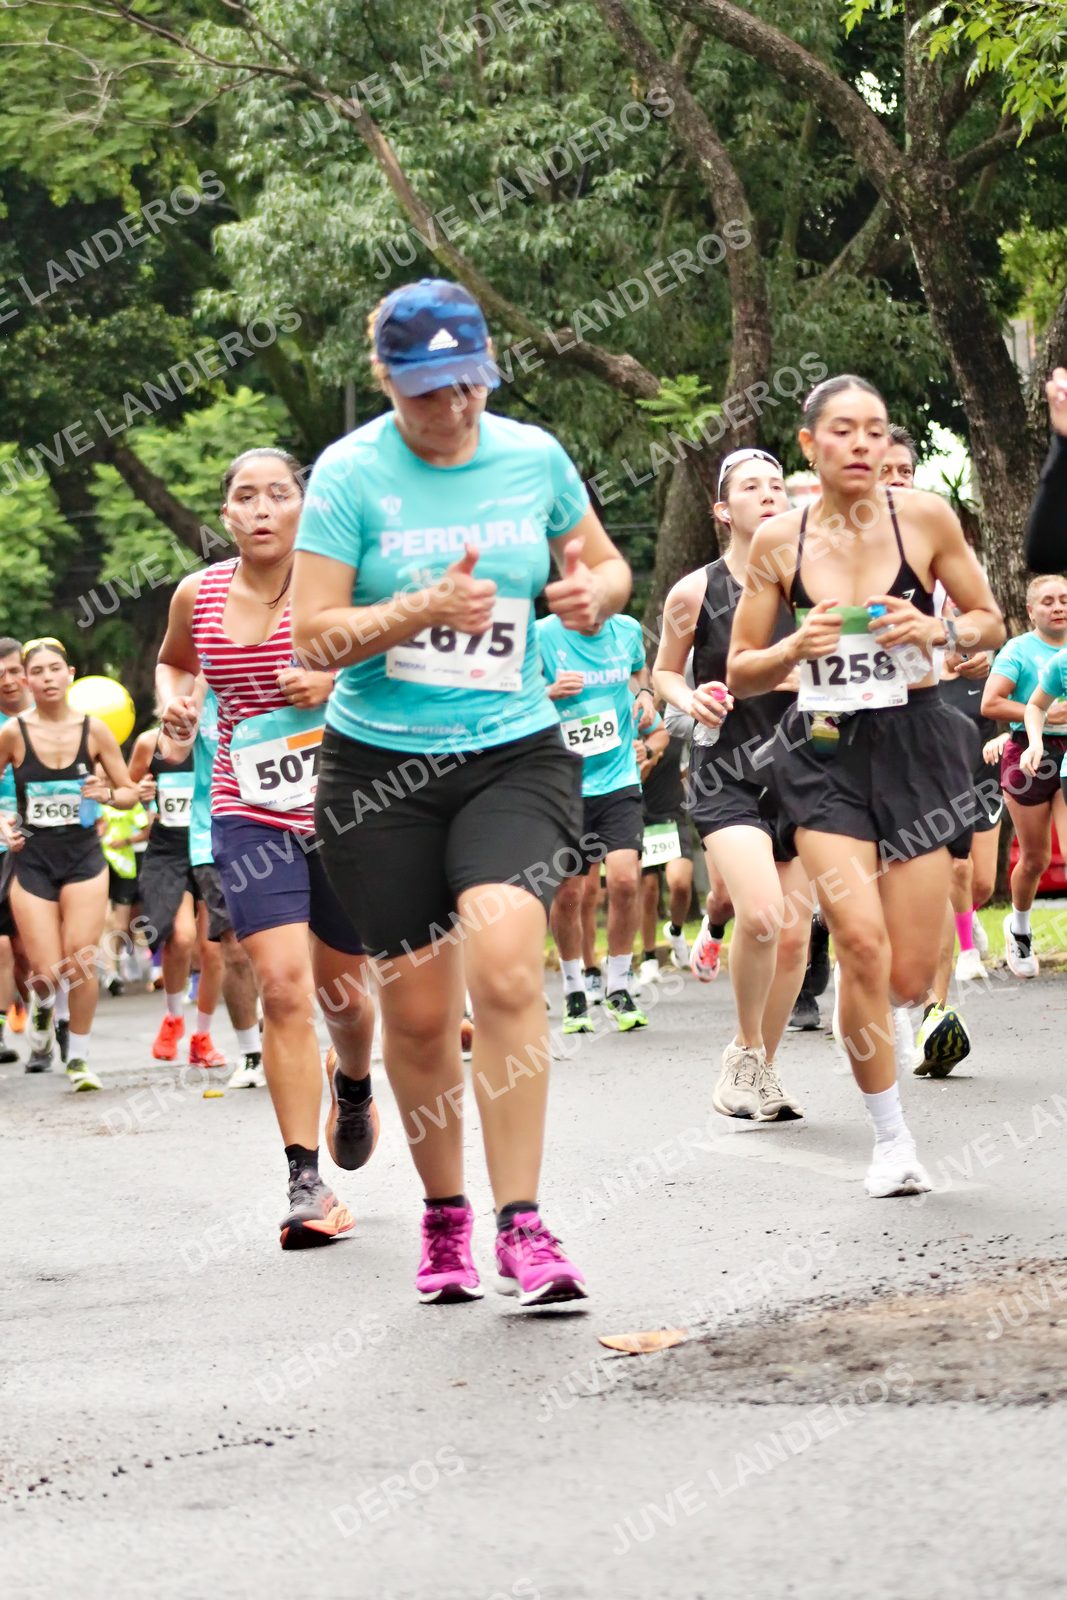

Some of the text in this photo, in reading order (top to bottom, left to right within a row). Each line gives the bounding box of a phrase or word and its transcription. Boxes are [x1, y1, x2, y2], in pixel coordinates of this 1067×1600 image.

[380, 519, 539, 557] PERDURA
[806, 651, 896, 686] 1258
[567, 721, 615, 746] 5249
[164, 798, 193, 812] 67
